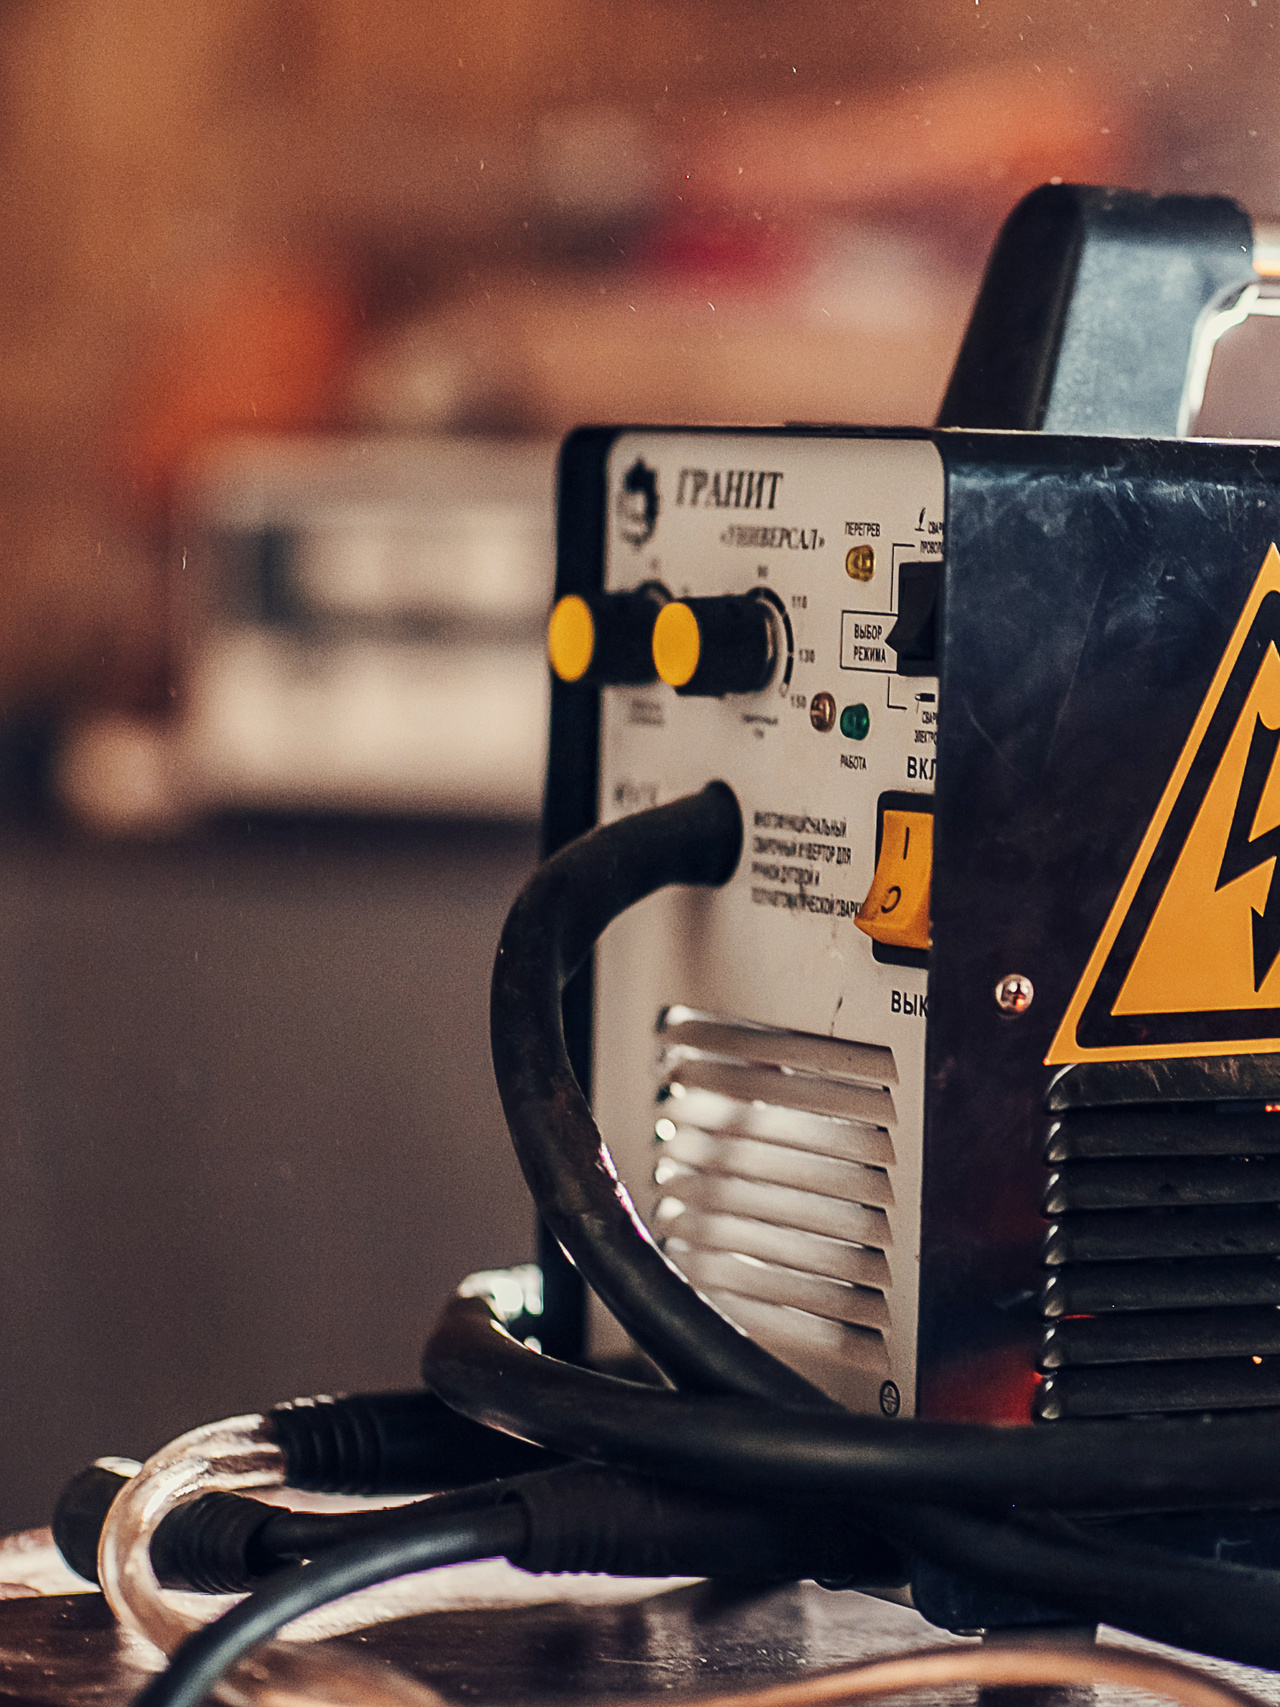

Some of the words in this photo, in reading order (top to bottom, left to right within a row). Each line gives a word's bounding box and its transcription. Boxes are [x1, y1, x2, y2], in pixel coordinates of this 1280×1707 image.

[676, 468, 784, 510] ГРАНИТ
[845, 521, 881, 537] ПЕРЕГРЕВ
[854, 624, 882, 640] ВЫБОР
[853, 646, 886, 663] РЕЖИМА
[840, 754, 867, 771] РАБОТА
[907, 756, 937, 780] ВКЛ
